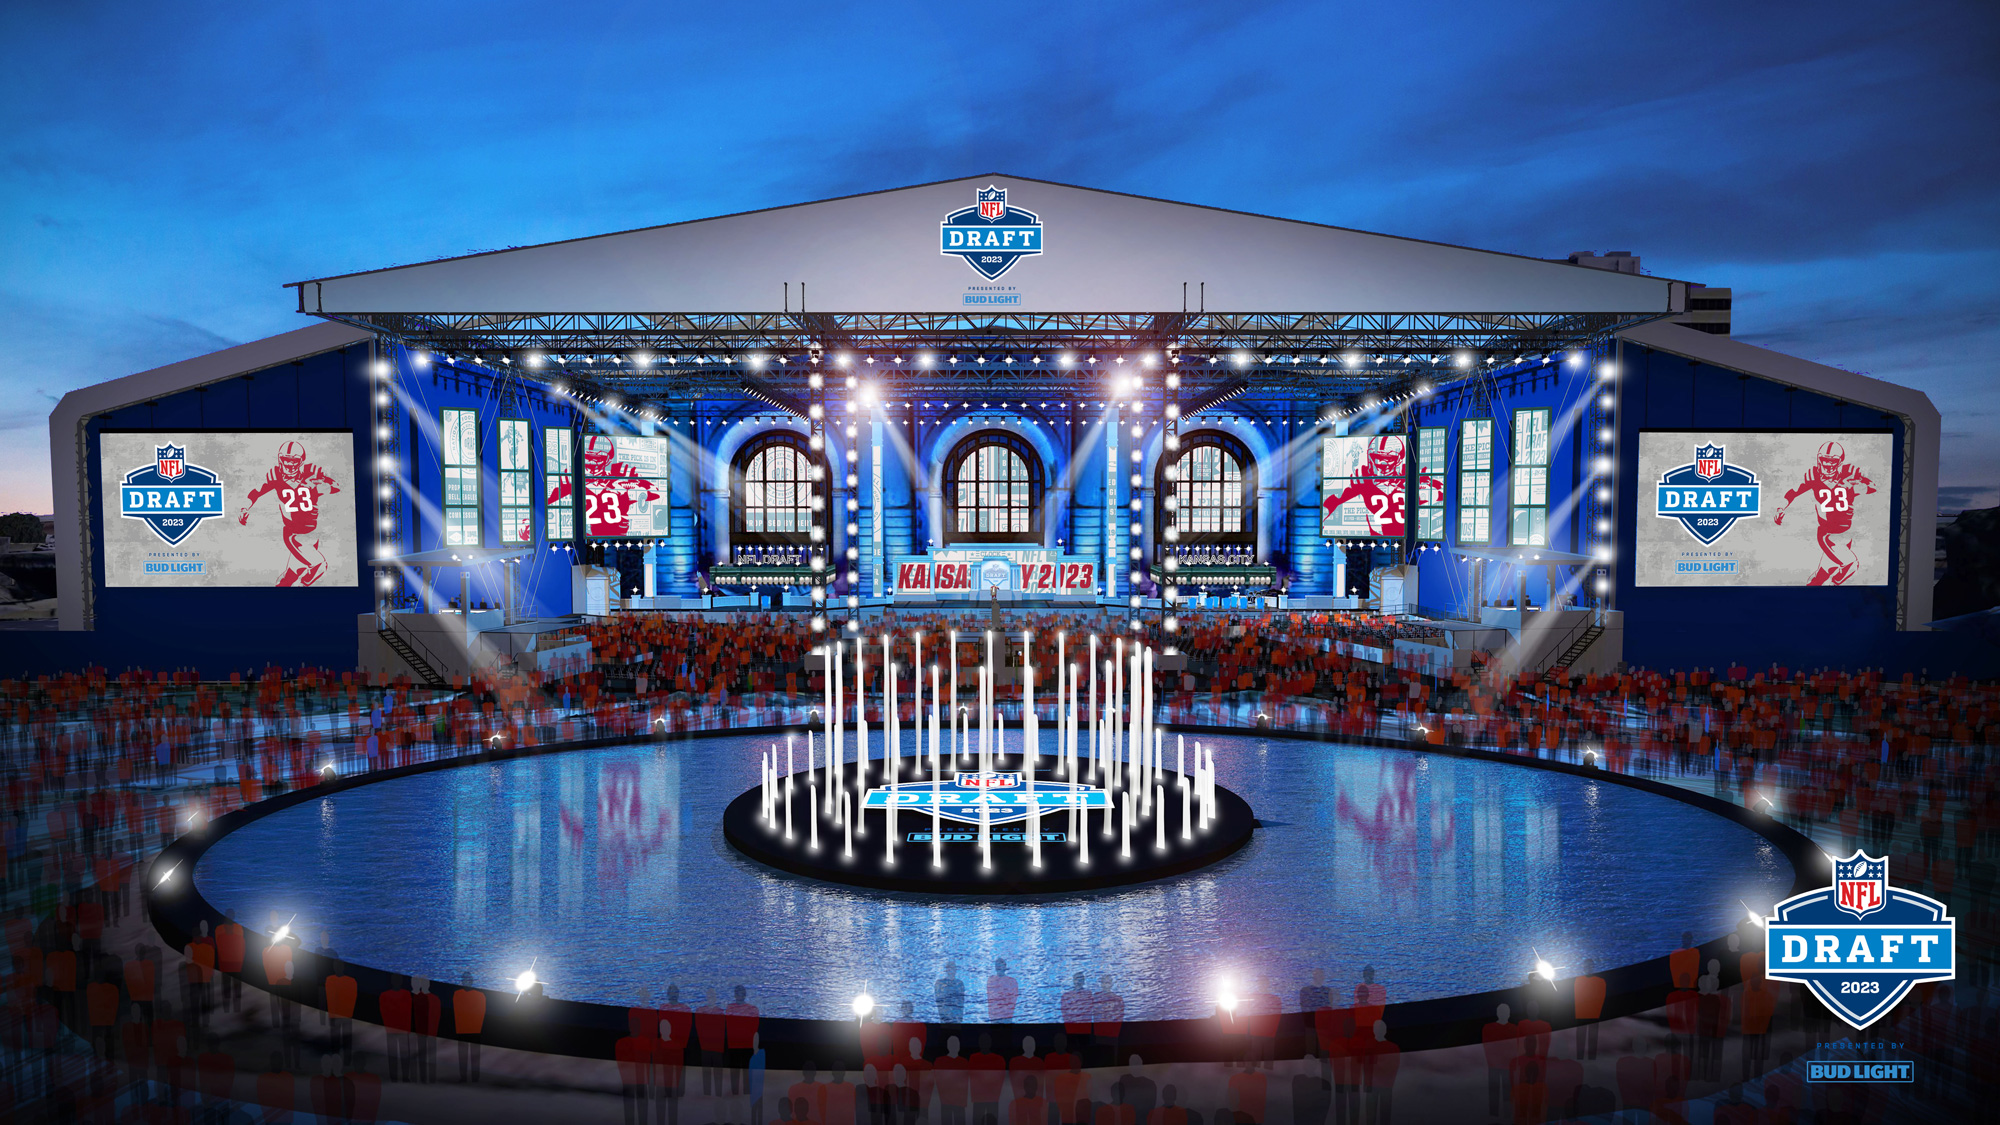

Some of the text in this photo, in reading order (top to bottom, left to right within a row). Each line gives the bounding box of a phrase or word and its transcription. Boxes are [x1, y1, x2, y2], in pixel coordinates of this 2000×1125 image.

[981, 202, 1003, 217] NFL
[949, 231, 1034, 246] DRAFT
[965, 296, 1019, 304] BUD LIGHT
[159, 460, 182, 477] NFL
[1698, 459, 1720, 477] NFL
[129, 491, 215, 509] DRAFT
[281, 487, 313, 513] 23
[1665, 491, 1752, 508] DRAFT
[1818, 487, 1849, 513] 23
[585, 492, 622, 525] 23
[162, 518, 184, 527] 2023
[1697, 518, 1719, 527] 2023
[737, 554, 802, 565] NFL DRAFT
[1178, 554, 1255, 565] KANSAS CITY
[1677, 562, 1736, 572] BUD LIGHT
[145, 563, 203, 573] BUD LIGHT
[898, 564, 972, 589] KANSA
[1037, 564, 1094, 589] 2023
[965, 779, 1013, 787] NFL
[884, 793, 1089, 804] DRAFT
